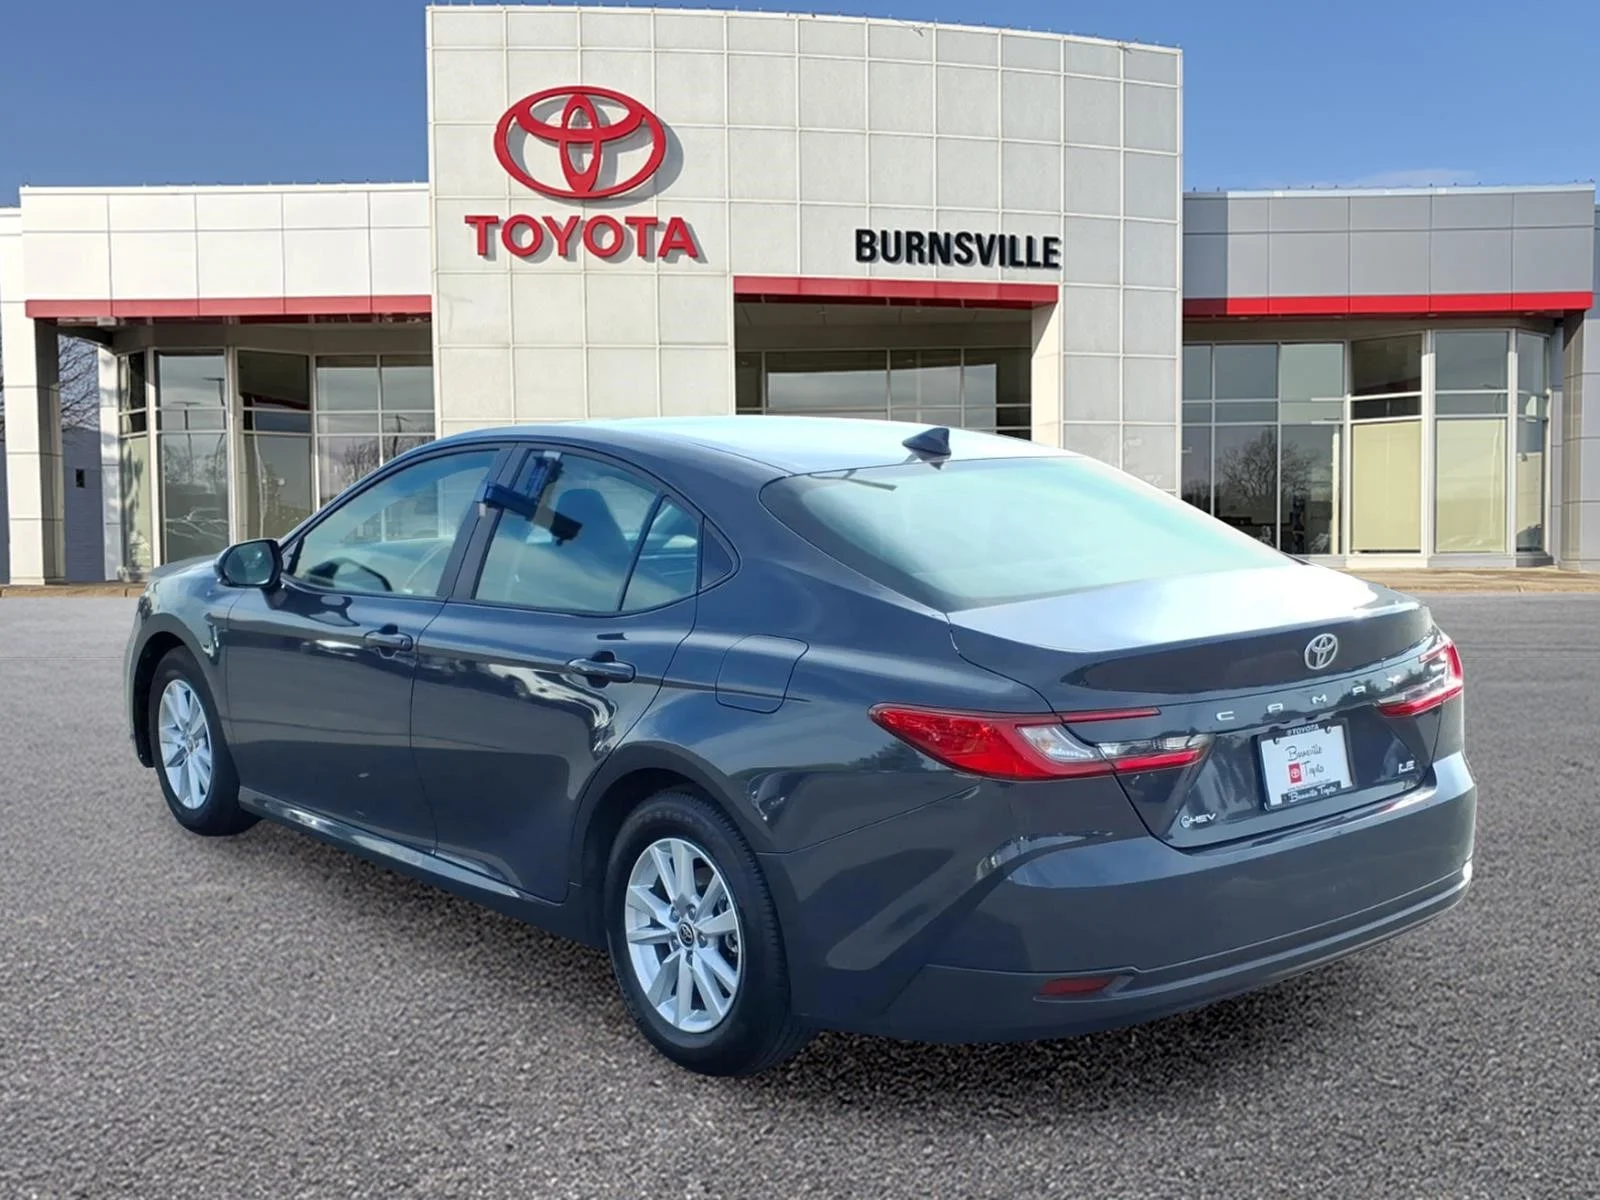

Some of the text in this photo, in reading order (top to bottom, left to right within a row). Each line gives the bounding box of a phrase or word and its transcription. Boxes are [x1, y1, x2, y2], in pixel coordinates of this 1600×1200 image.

[464, 214, 699, 258] TOYOTA
[855, 228, 1061, 269] BURNSVILLE
[1291, 723, 1320, 735] TOYOTA
[1397, 760, 1416, 775] LE
